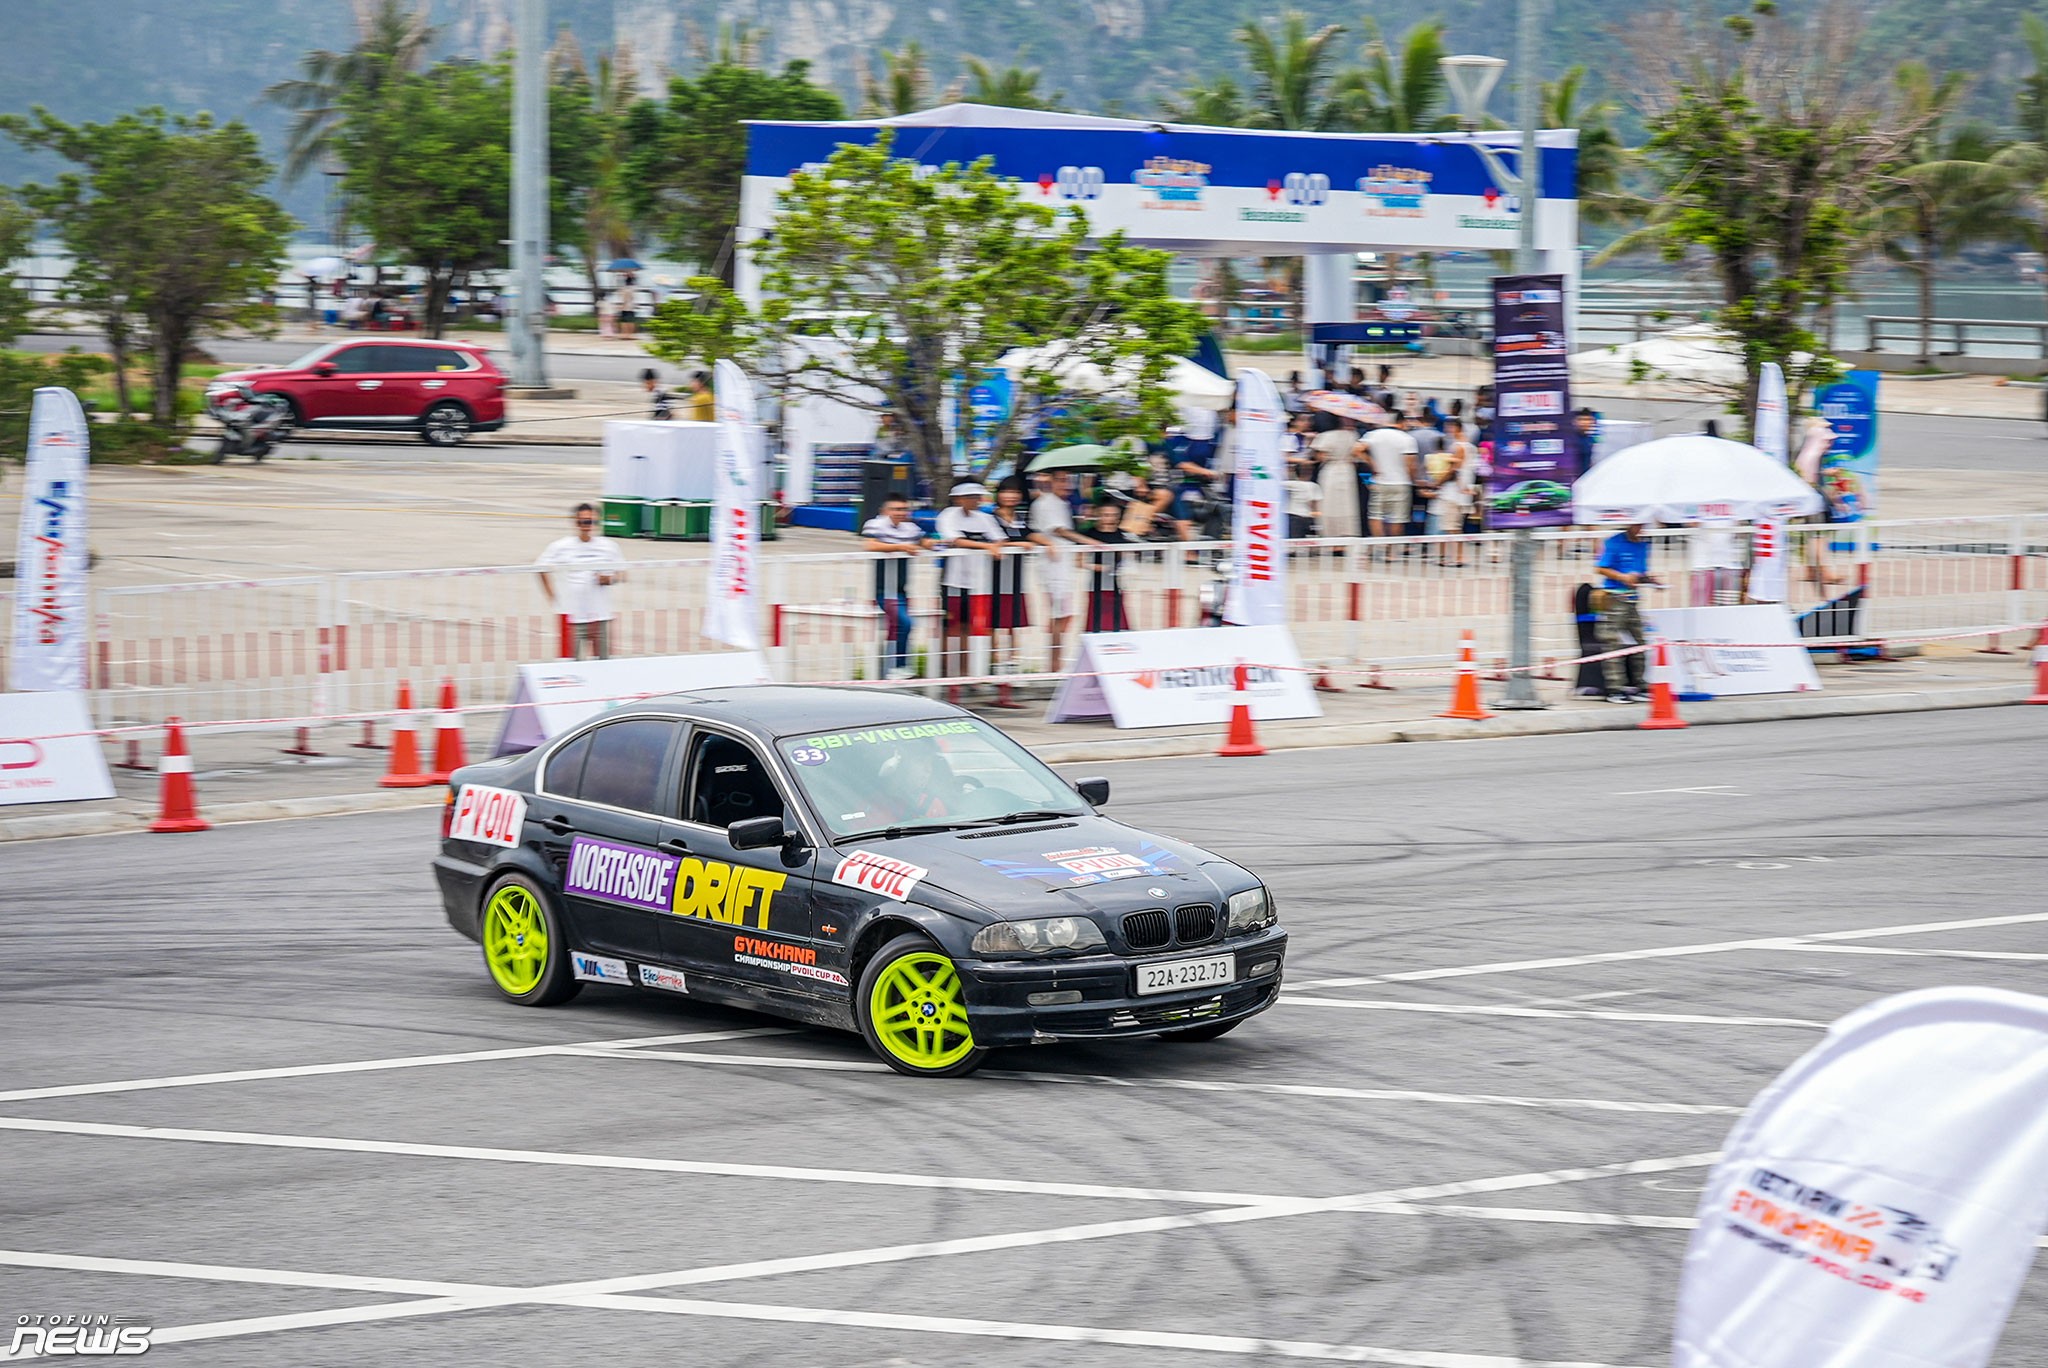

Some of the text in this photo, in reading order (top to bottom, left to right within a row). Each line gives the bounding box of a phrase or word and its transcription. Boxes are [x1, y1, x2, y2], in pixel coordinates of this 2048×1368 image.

[1247, 499, 1276, 586] PVOIL
[898, 721, 979, 741] GARAGE
[793, 748, 825, 763] 33
[456, 788, 517, 843] PVOIL
[838, 853, 917, 897] PVOIL
[1065, 856, 1143, 872] PVOIL
[568, 843, 788, 931] NORTHSIDE DRIFT
[734, 935, 817, 966] GYMKHANA
[734, 953, 791, 972] CHAMPIONSHIP
[791, 965, 815, 976] PVOIL
[815, 970, 831, 979] CUP
[1147, 961, 1228, 988] 22A-232.73
